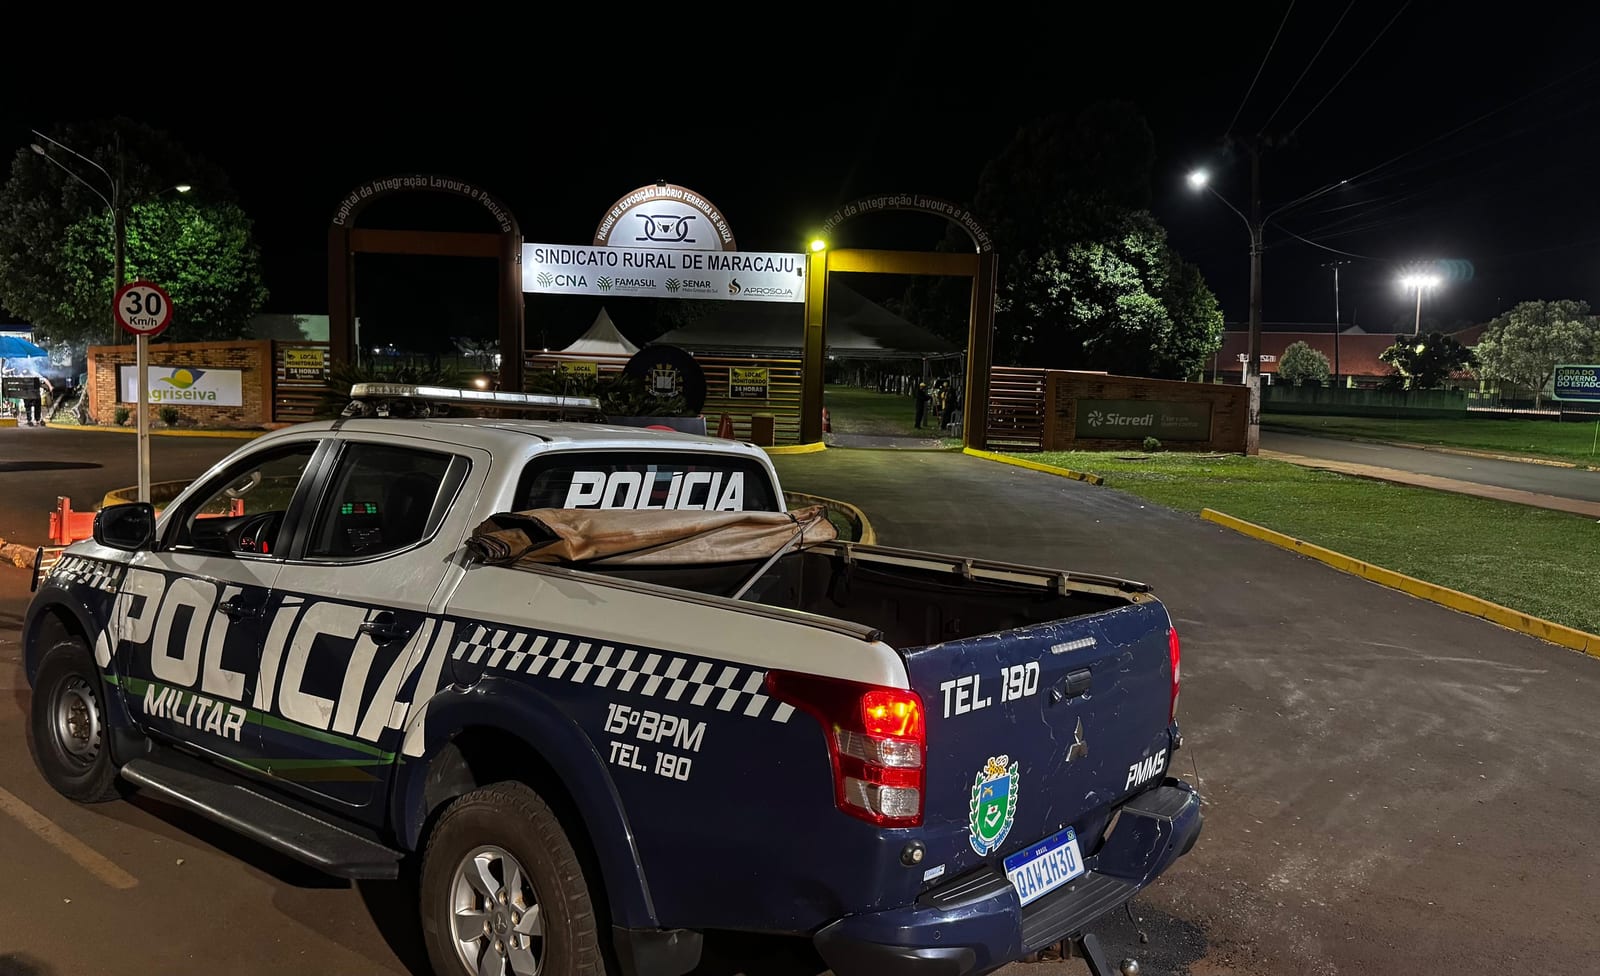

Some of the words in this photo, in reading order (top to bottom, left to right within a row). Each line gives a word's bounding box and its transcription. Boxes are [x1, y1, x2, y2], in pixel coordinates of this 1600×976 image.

[333, 191, 360, 226] Capital
[359, 185, 373, 199] da
[373, 174, 428, 193] Integração
[430, 175, 471, 195] Lavoura
[471, 188, 478, 198] e
[479, 191, 512, 233] Pecuária
[597, 214, 616, 241] PARQUE
[612, 206, 623, 218] DE
[619, 187, 655, 212] EXPOSIÇÃO
[656, 186, 683, 199] LIBÓRIO
[683, 191, 712, 216] FERREIRA
[710, 211, 721, 223] DE
[716, 220, 733, 244] SOUZA
[844, 204, 857, 218] da
[857, 193, 912, 212] Integração
[913, 194, 954, 215] Lavoura
[953, 208, 961, 218] e
[960, 211, 992, 252] Pecuária
[535, 248, 618, 267] SINDICATO
[623, 252, 676, 269] RURAL
[682, 254, 703, 270] DE
[708, 255, 794, 273] MARACAJU
[555, 275, 588, 287] CNA
[615, 277, 657, 287] FAMASUL
[682, 279, 711, 288] SENAR
[743, 287, 793, 295] APROSOJA
[126, 291, 162, 316] 30
[129, 316, 158, 327] Km/h
[1106, 413, 1153, 427] Sicredi
[940, 674, 992, 719] TEL.
[1001, 661, 1040, 703] 190
[143, 683, 247, 742] MILITAR
[609, 740, 647, 772] TEL.
[654, 752, 692, 781] 190
[1125, 748, 1166, 791] PMMS
[1016, 846, 1076, 898] QAW1H30
